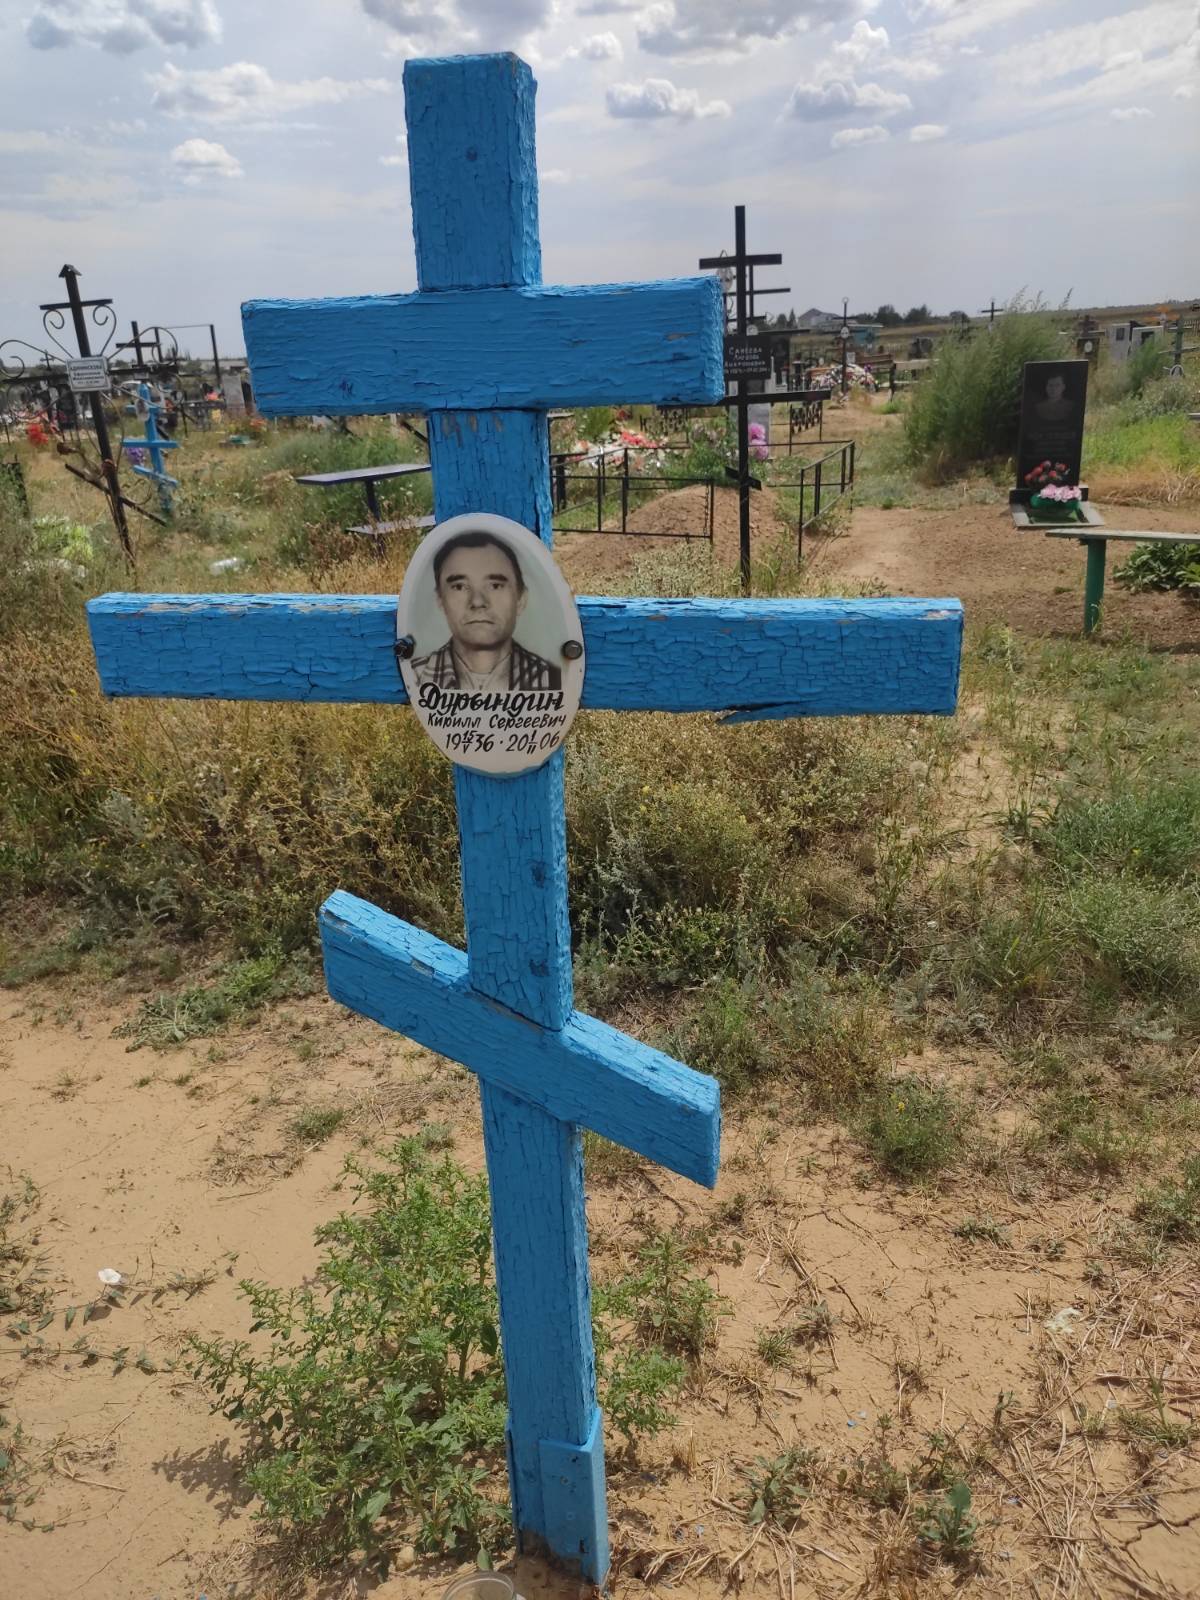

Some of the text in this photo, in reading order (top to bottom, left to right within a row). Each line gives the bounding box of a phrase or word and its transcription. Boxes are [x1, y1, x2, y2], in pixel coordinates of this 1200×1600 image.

[418, 682, 564, 717] Дурындин
[427, 712, 567, 731] Кирилл Сергеевич
